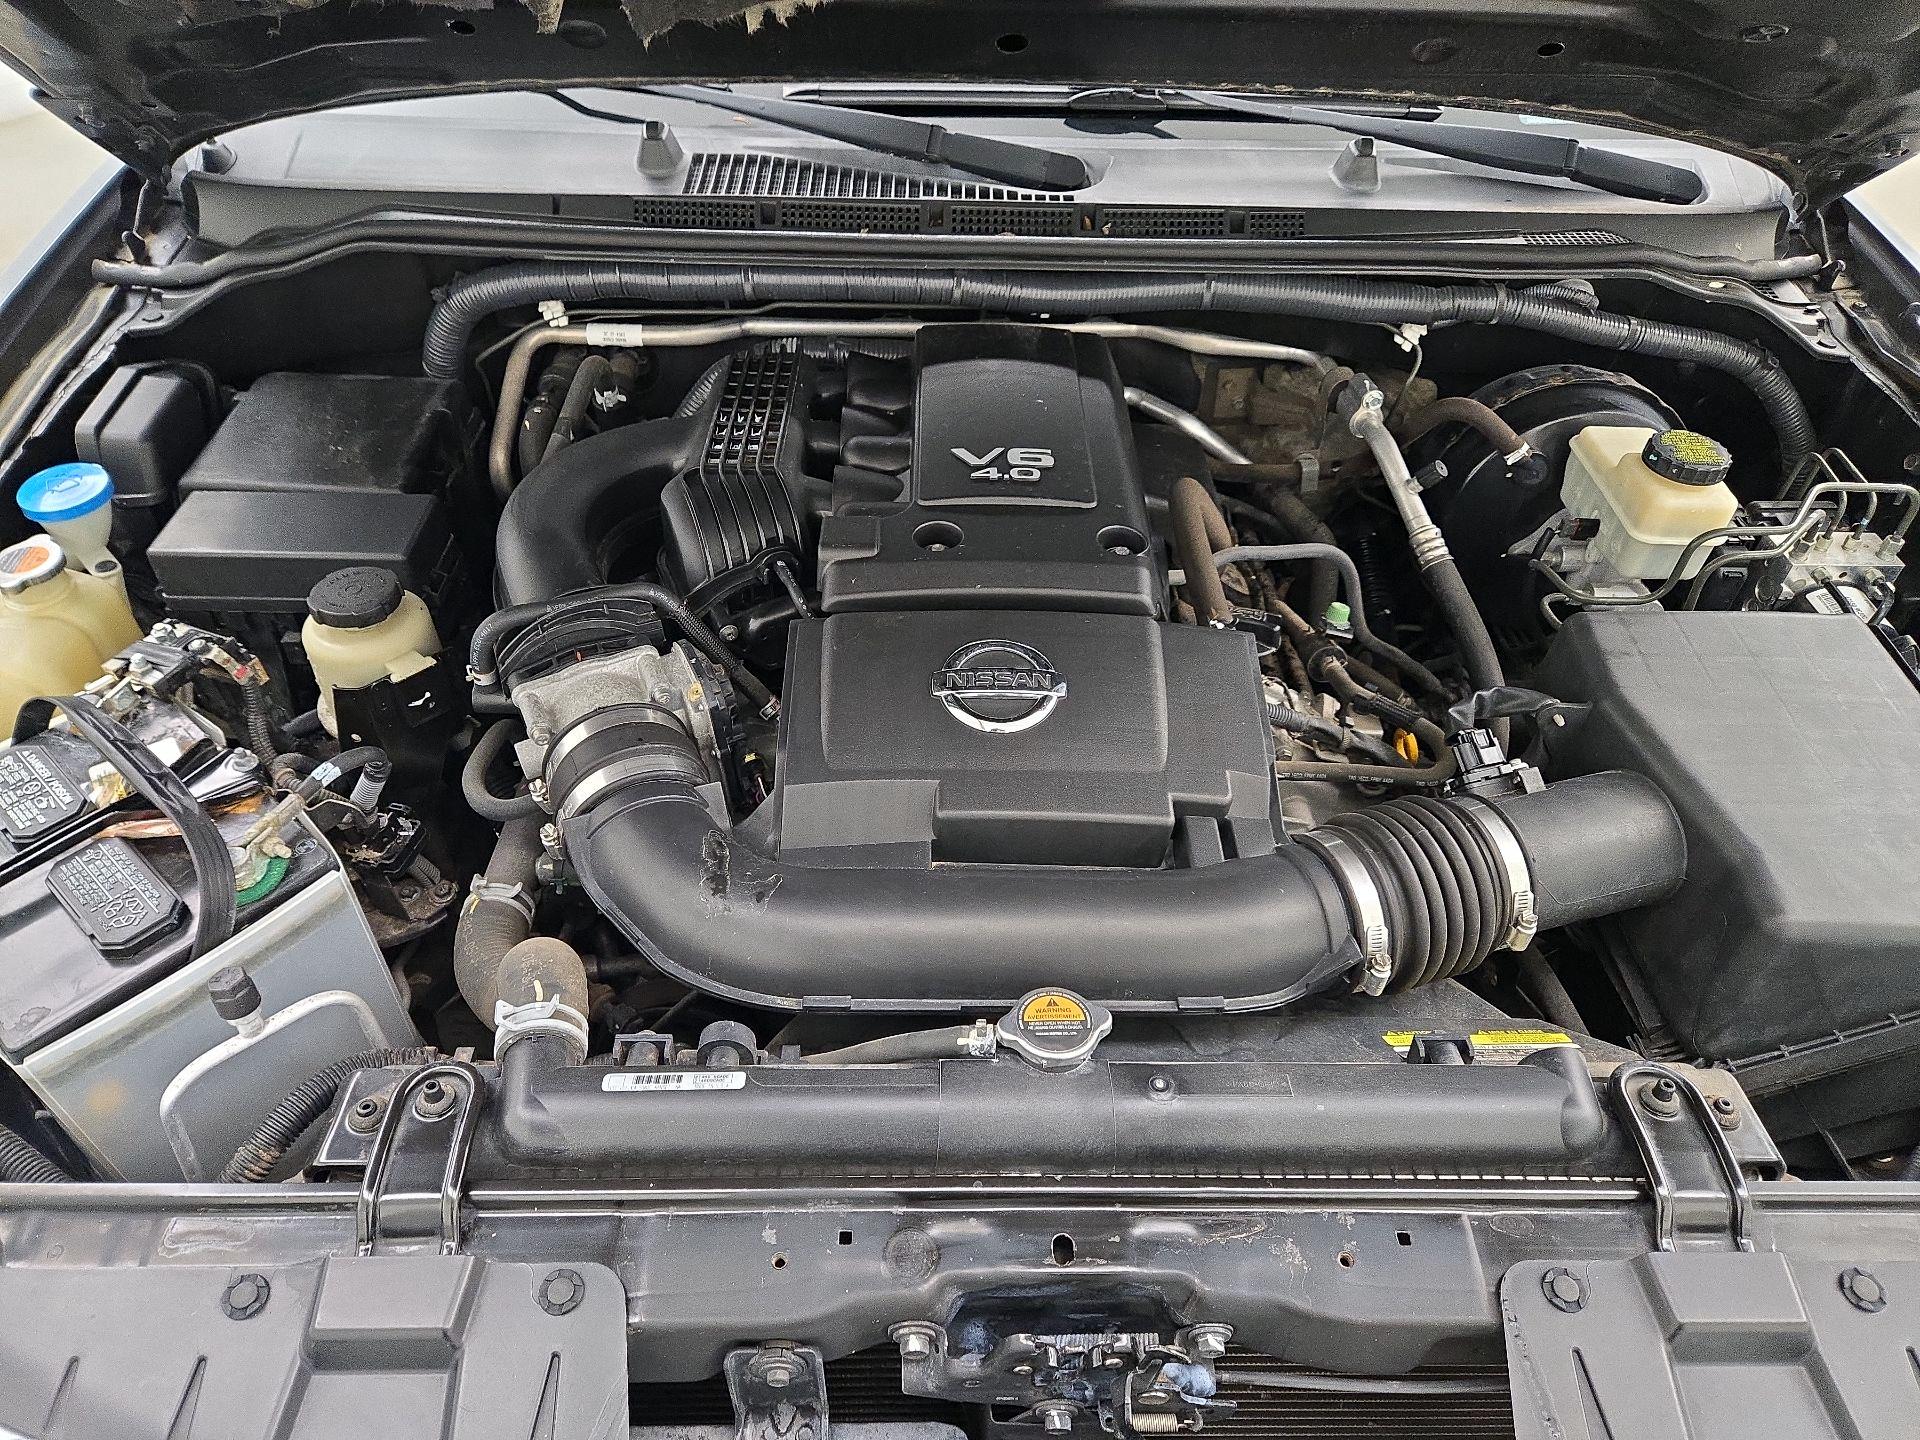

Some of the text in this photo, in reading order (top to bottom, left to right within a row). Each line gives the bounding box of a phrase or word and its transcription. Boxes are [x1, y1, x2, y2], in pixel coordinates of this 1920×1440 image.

[950, 447, 1055, 468] V6
[970, 467, 1041, 480] 4.0
[946, 671, 1052, 688] NISSAN
